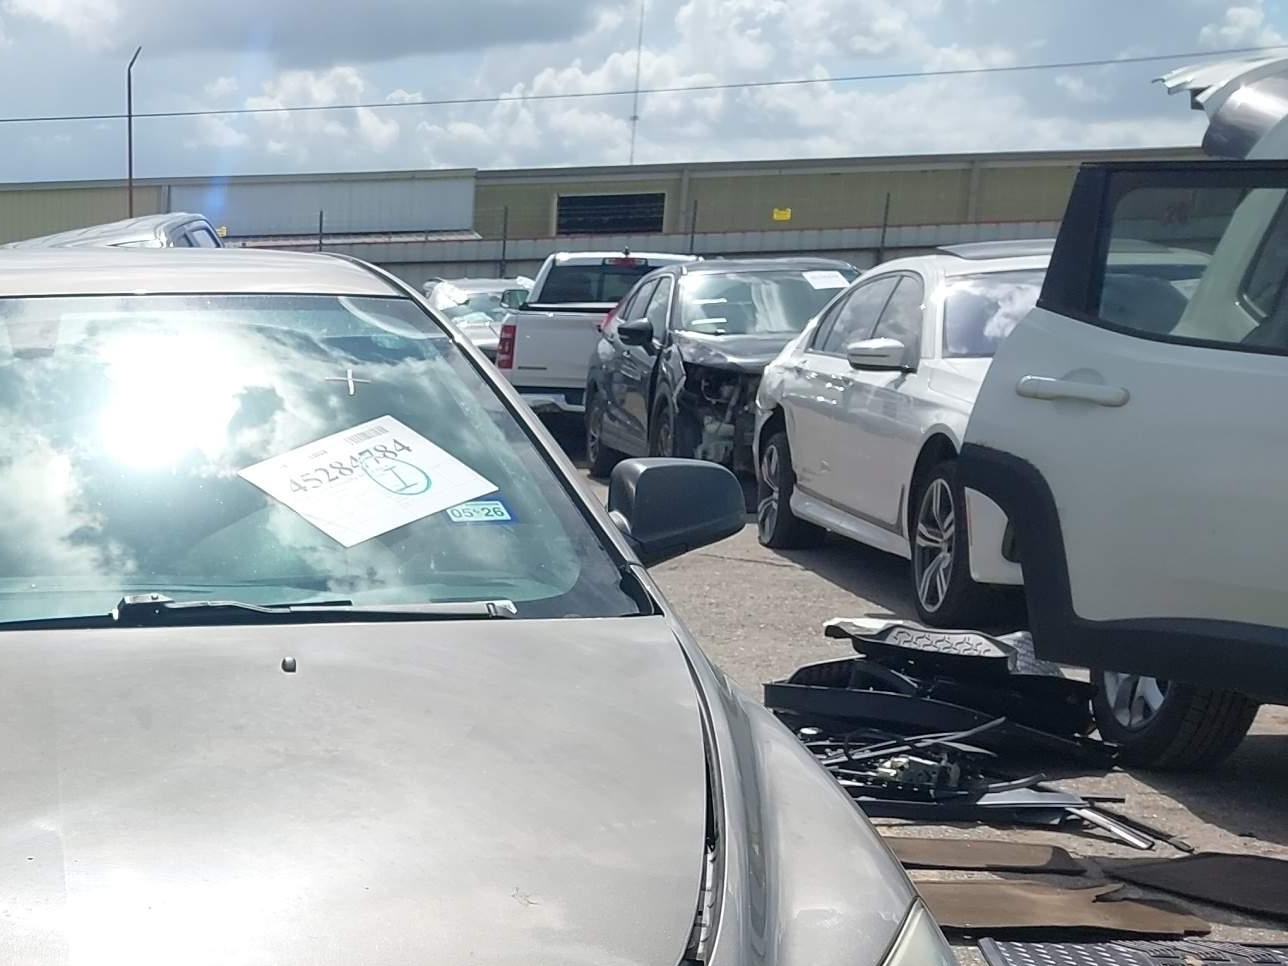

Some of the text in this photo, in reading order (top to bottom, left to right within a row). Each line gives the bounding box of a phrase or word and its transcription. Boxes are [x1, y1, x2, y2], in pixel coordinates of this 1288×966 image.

[289, 438, 413, 493] 45284784
[450, 507, 505, 518] 05 26
